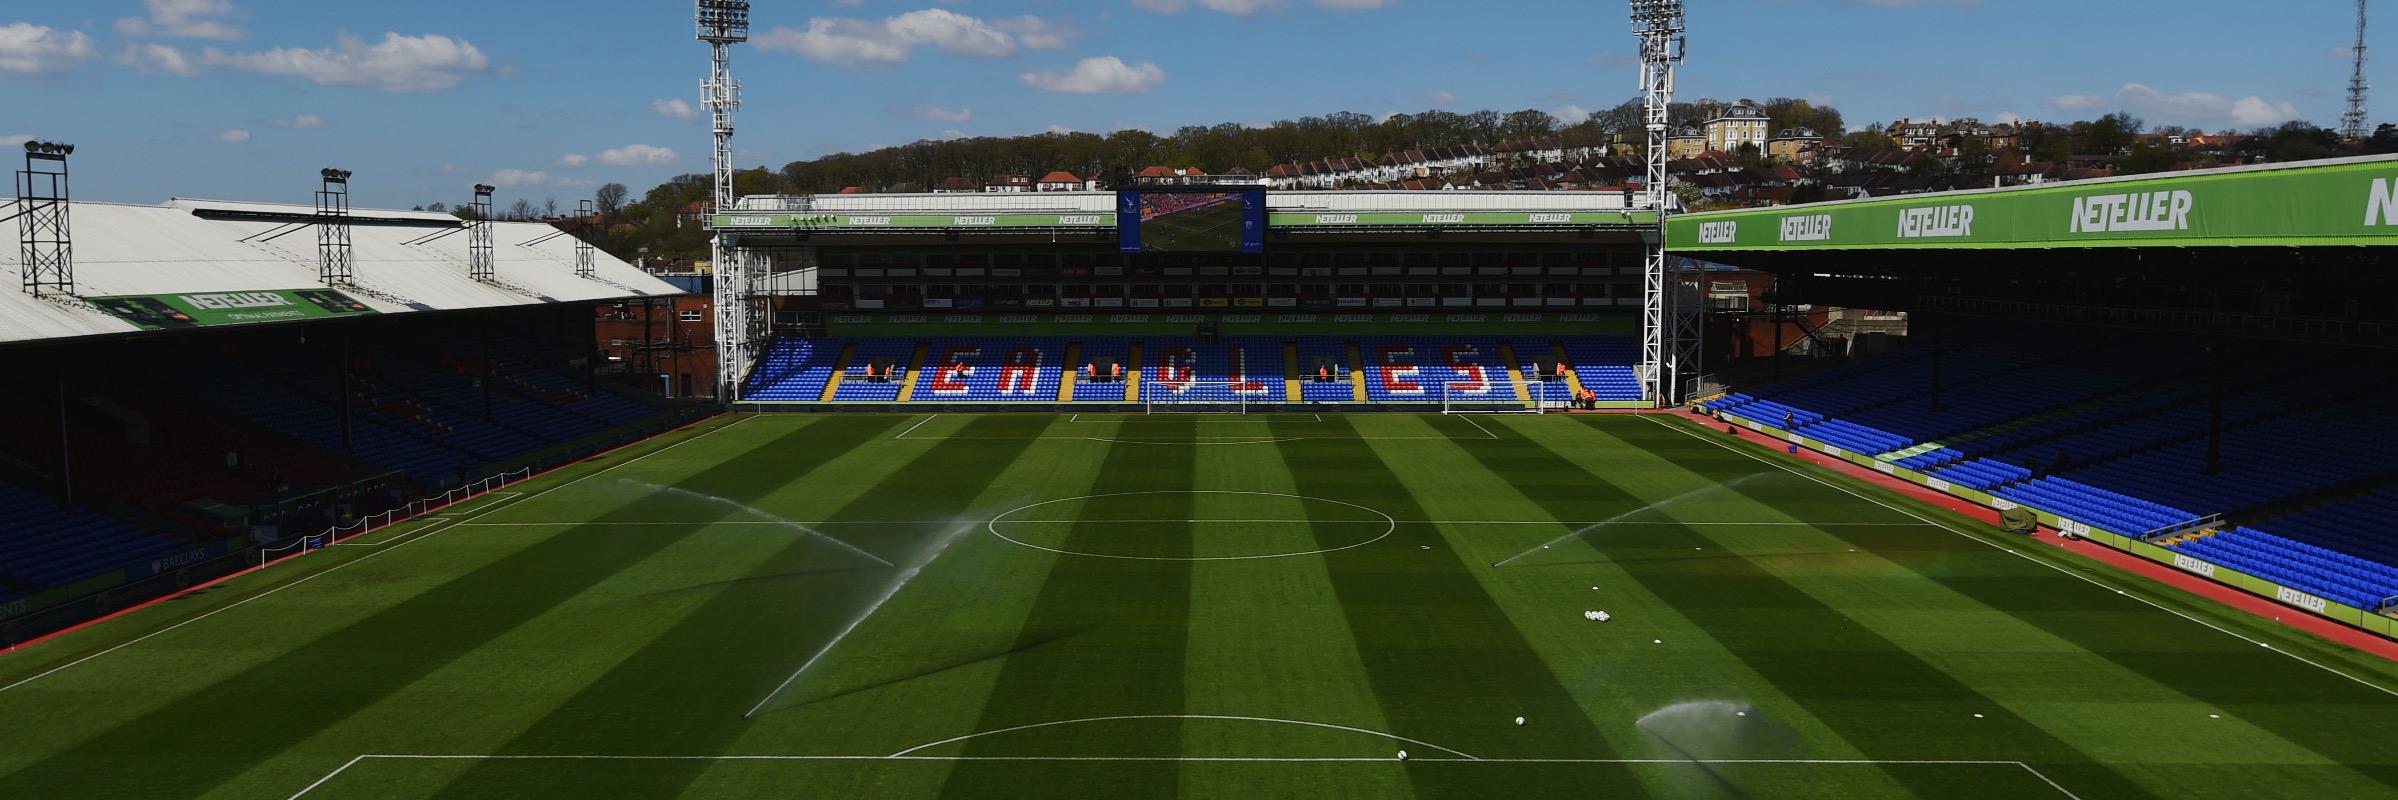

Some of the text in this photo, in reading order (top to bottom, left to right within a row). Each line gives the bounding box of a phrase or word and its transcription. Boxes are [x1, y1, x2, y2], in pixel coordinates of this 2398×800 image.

[1058, 215, 1101, 225] NETELLER
[1315, 214, 1358, 224] NETELLER
[1422, 213, 1465, 223] NETELLER
[1528, 213, 1572, 223] NETELLER
[2070, 190, 2192, 232] NETELLER
[730, 217, 772, 226] NETELLER
[849, 216, 890, 226] NETELLER
[954, 216, 996, 226] NETELLER
[1780, 215, 1831, 241] NETELLER
[1897, 205, 1974, 238] NETELLER
[1698, 220, 1737, 244] NETELLER
[178, 292, 296, 310] NETELLER
[2058, 517, 2090, 537] NETELLER
[163, 548, 205, 571] BARCLAYS
[2174, 553, 2215, 577] NETELLER
[2277, 585, 2327, 613] NETELLER
